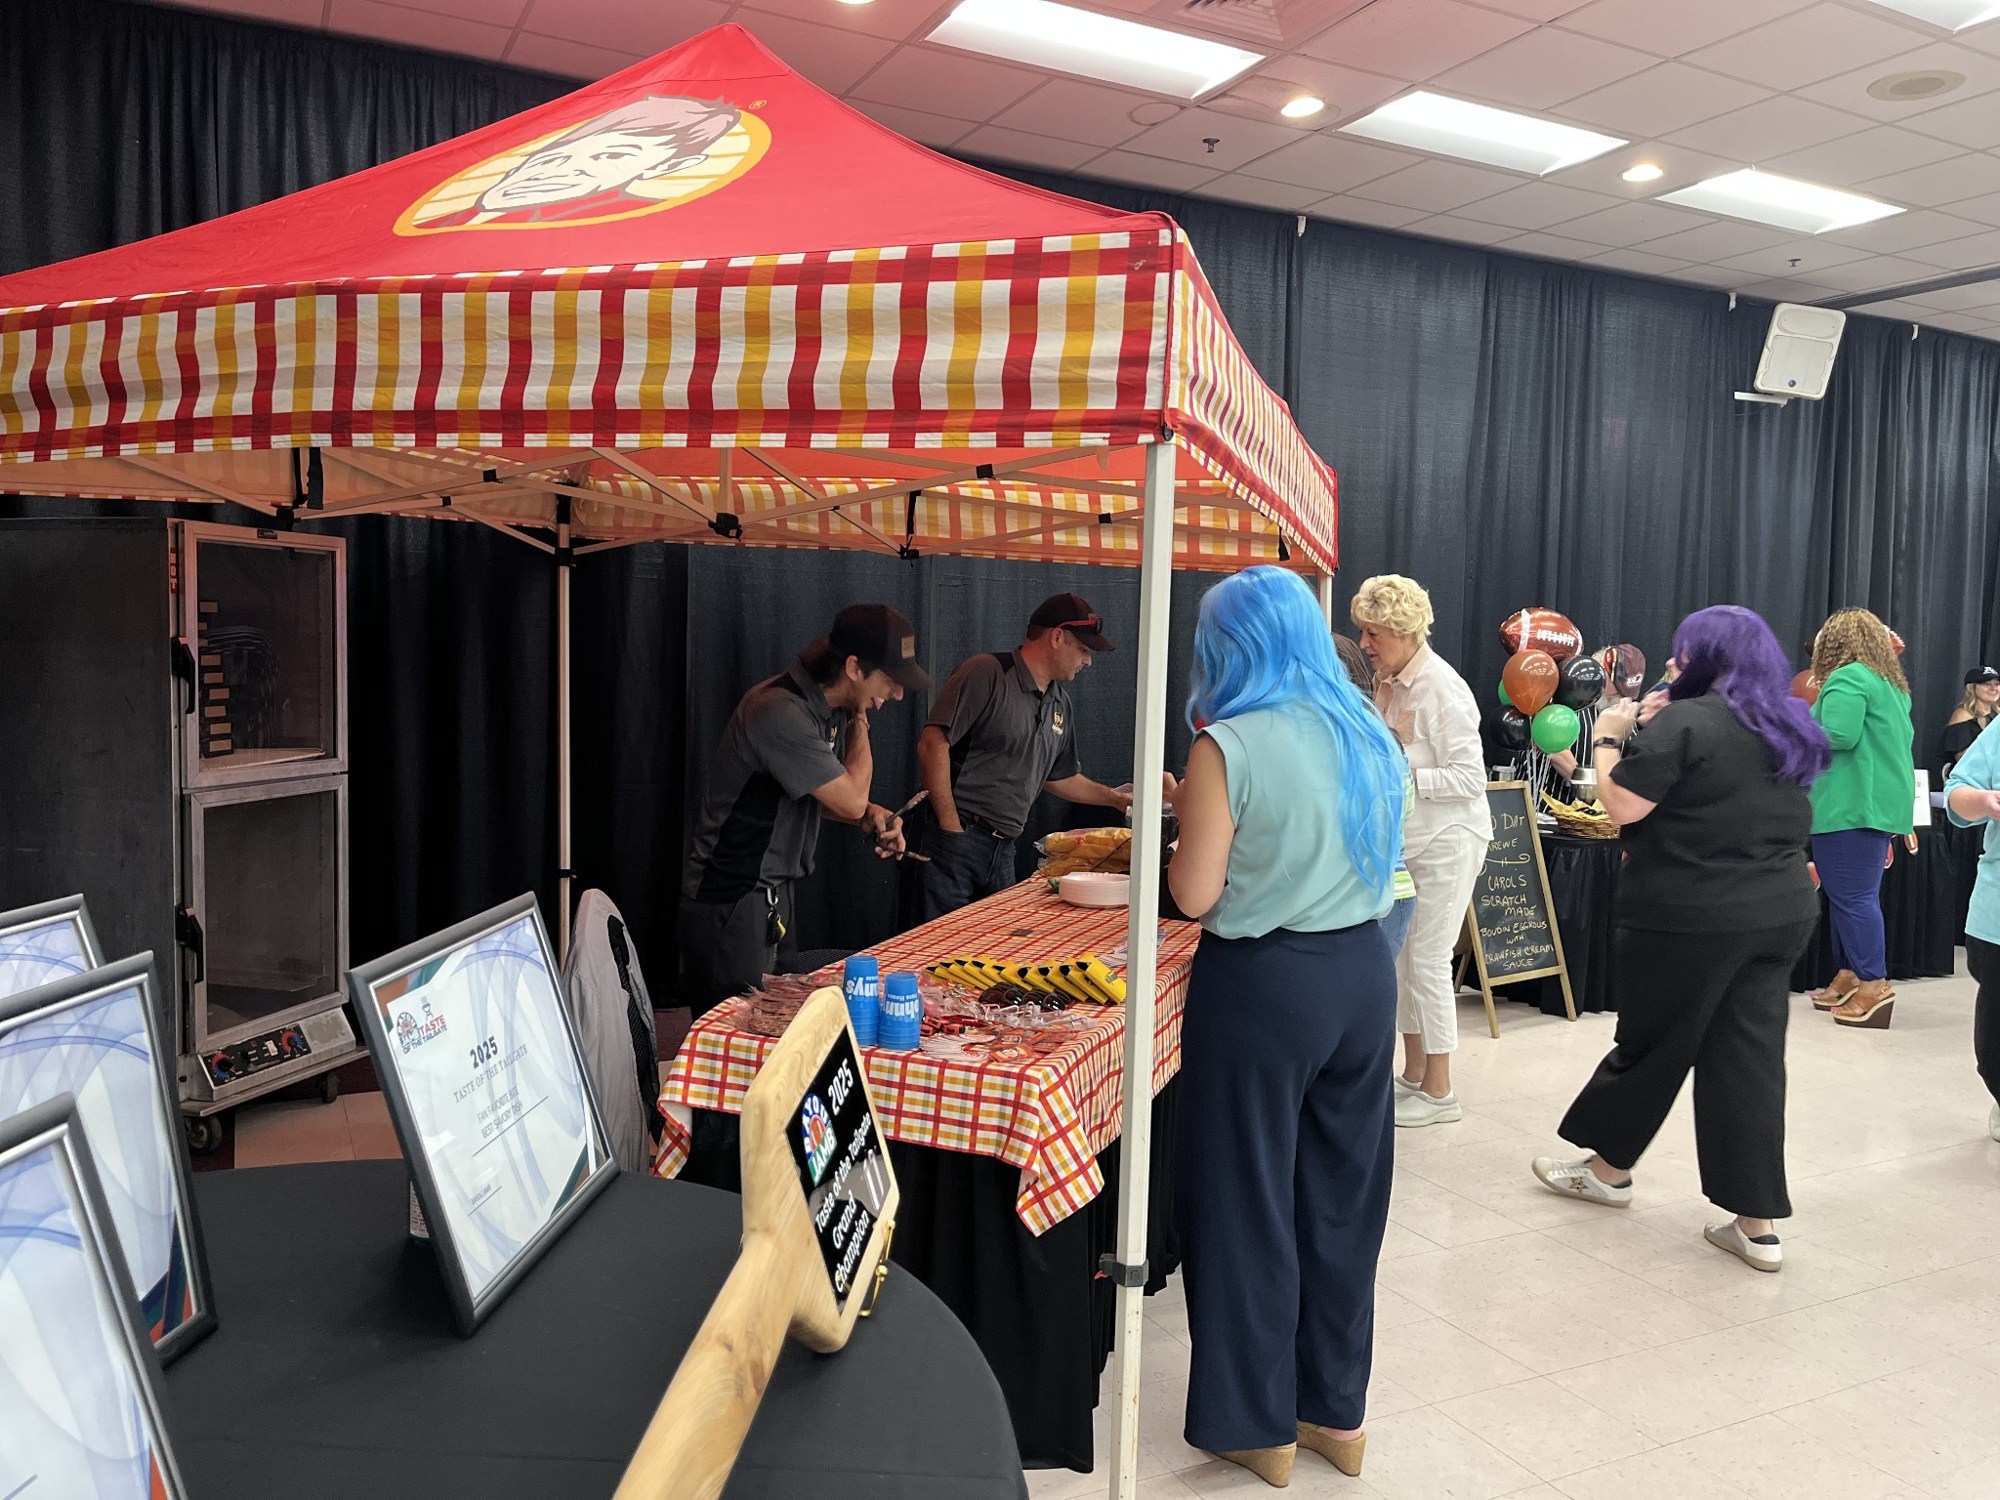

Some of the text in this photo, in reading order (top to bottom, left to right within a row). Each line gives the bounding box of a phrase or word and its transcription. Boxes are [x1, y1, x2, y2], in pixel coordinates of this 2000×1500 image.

[1500, 812, 1525, 830] DAT
[1481, 893, 1527, 907] SCRATCH
[1504, 905, 1537, 916] MADE
[1480, 924, 1511, 937] BOUDIN
[1484, 943, 1554, 965] CRAWFISH CREAM
[1502, 958, 1534, 971] SAUCE
[419, 1014, 446, 1035] TASTE
[403, 1045, 411, 1055] OF
[411, 1038, 423, 1049] THE
[470, 1035, 498, 1069] 2025
[453, 1043, 528, 1103] TASTE OF THE TAILGATE
[828, 1058, 853, 1115] 2025
[811, 1126, 834, 1184] JAMB
[815, 1111, 871, 1234] Taste of the Tailgate
[832, 1189, 857, 1249] Grand
[834, 1209, 870, 1293] Champion
